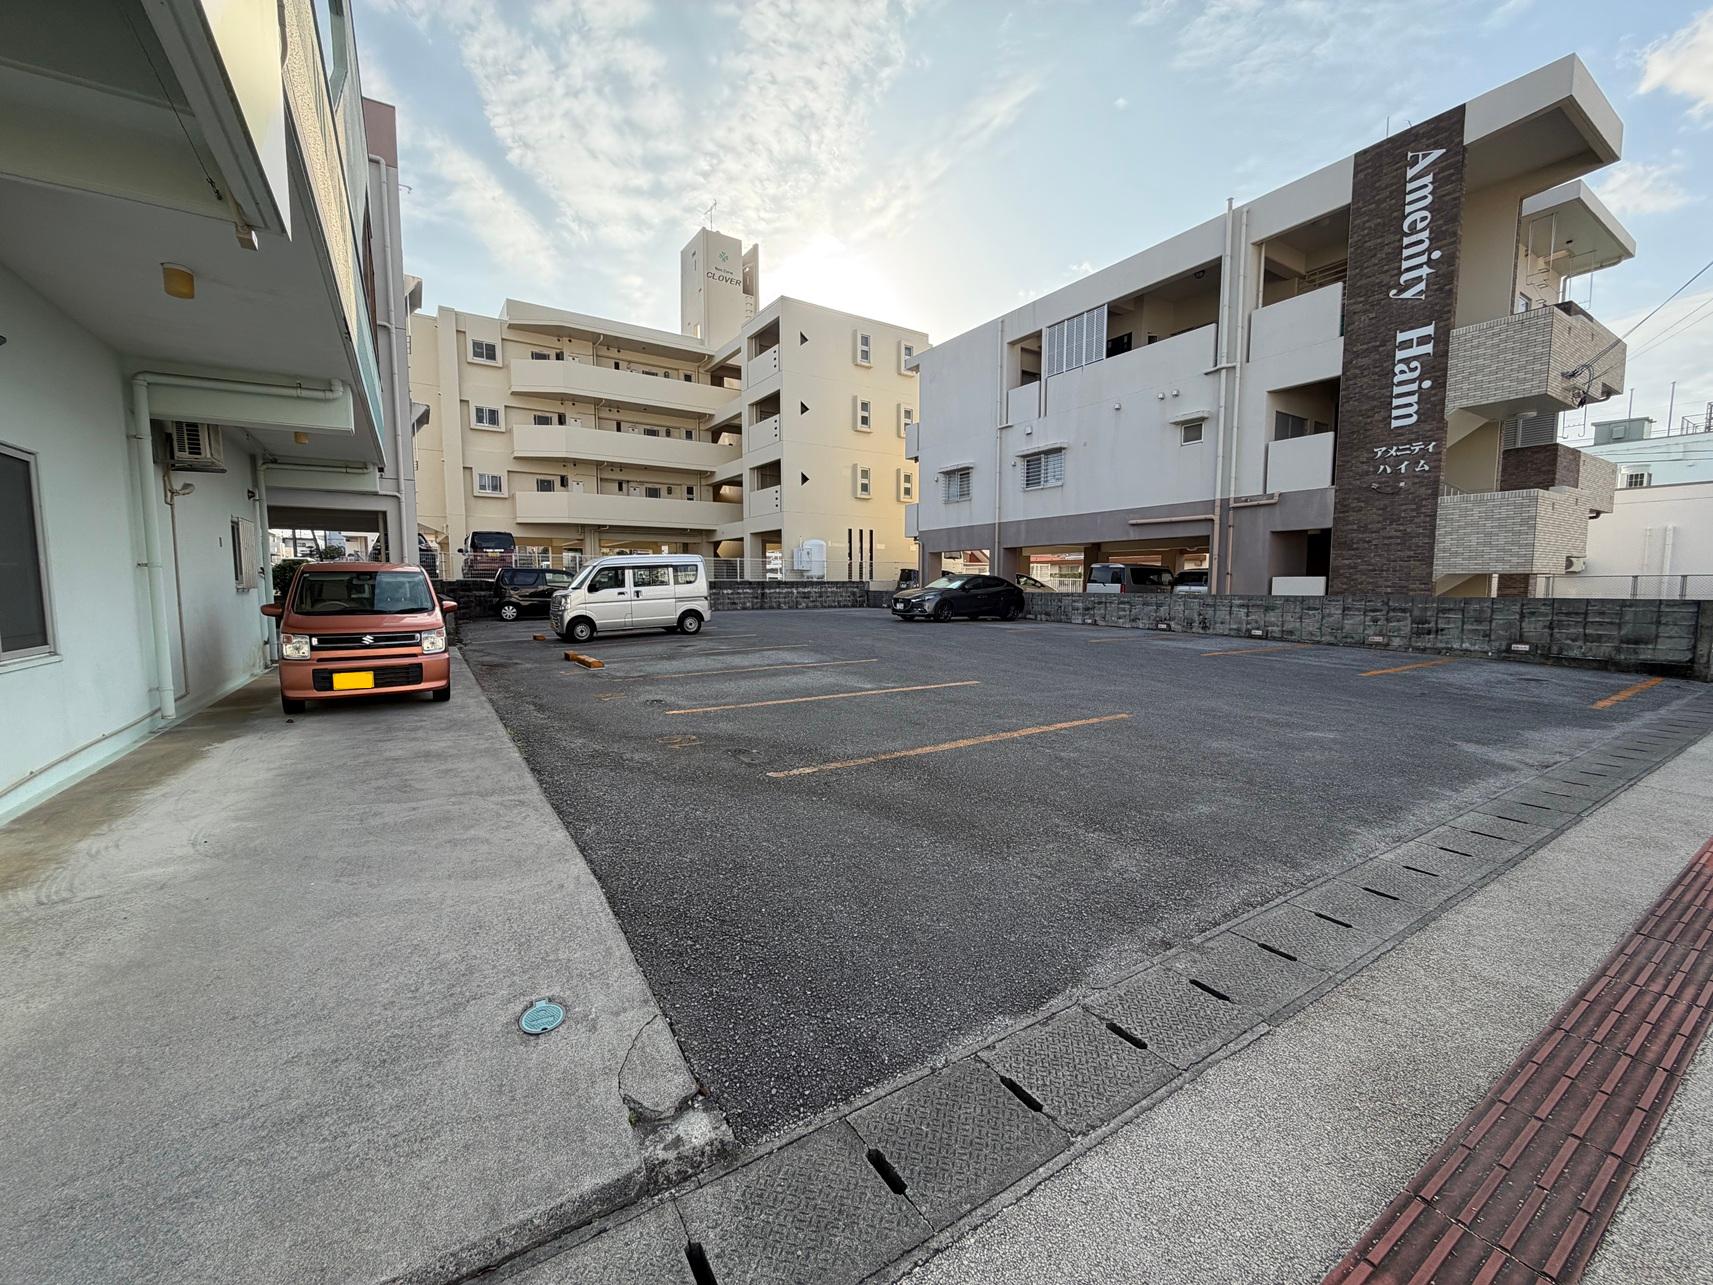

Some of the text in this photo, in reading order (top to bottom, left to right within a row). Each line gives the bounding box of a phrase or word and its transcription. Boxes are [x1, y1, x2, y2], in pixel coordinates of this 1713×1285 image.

[706, 271, 742, 287] CLOVER
[1389, 148, 1447, 429] Amenity Haim
[1373, 441, 1437, 460] アメニティ
[1376, 460, 1430, 475] ハイム
